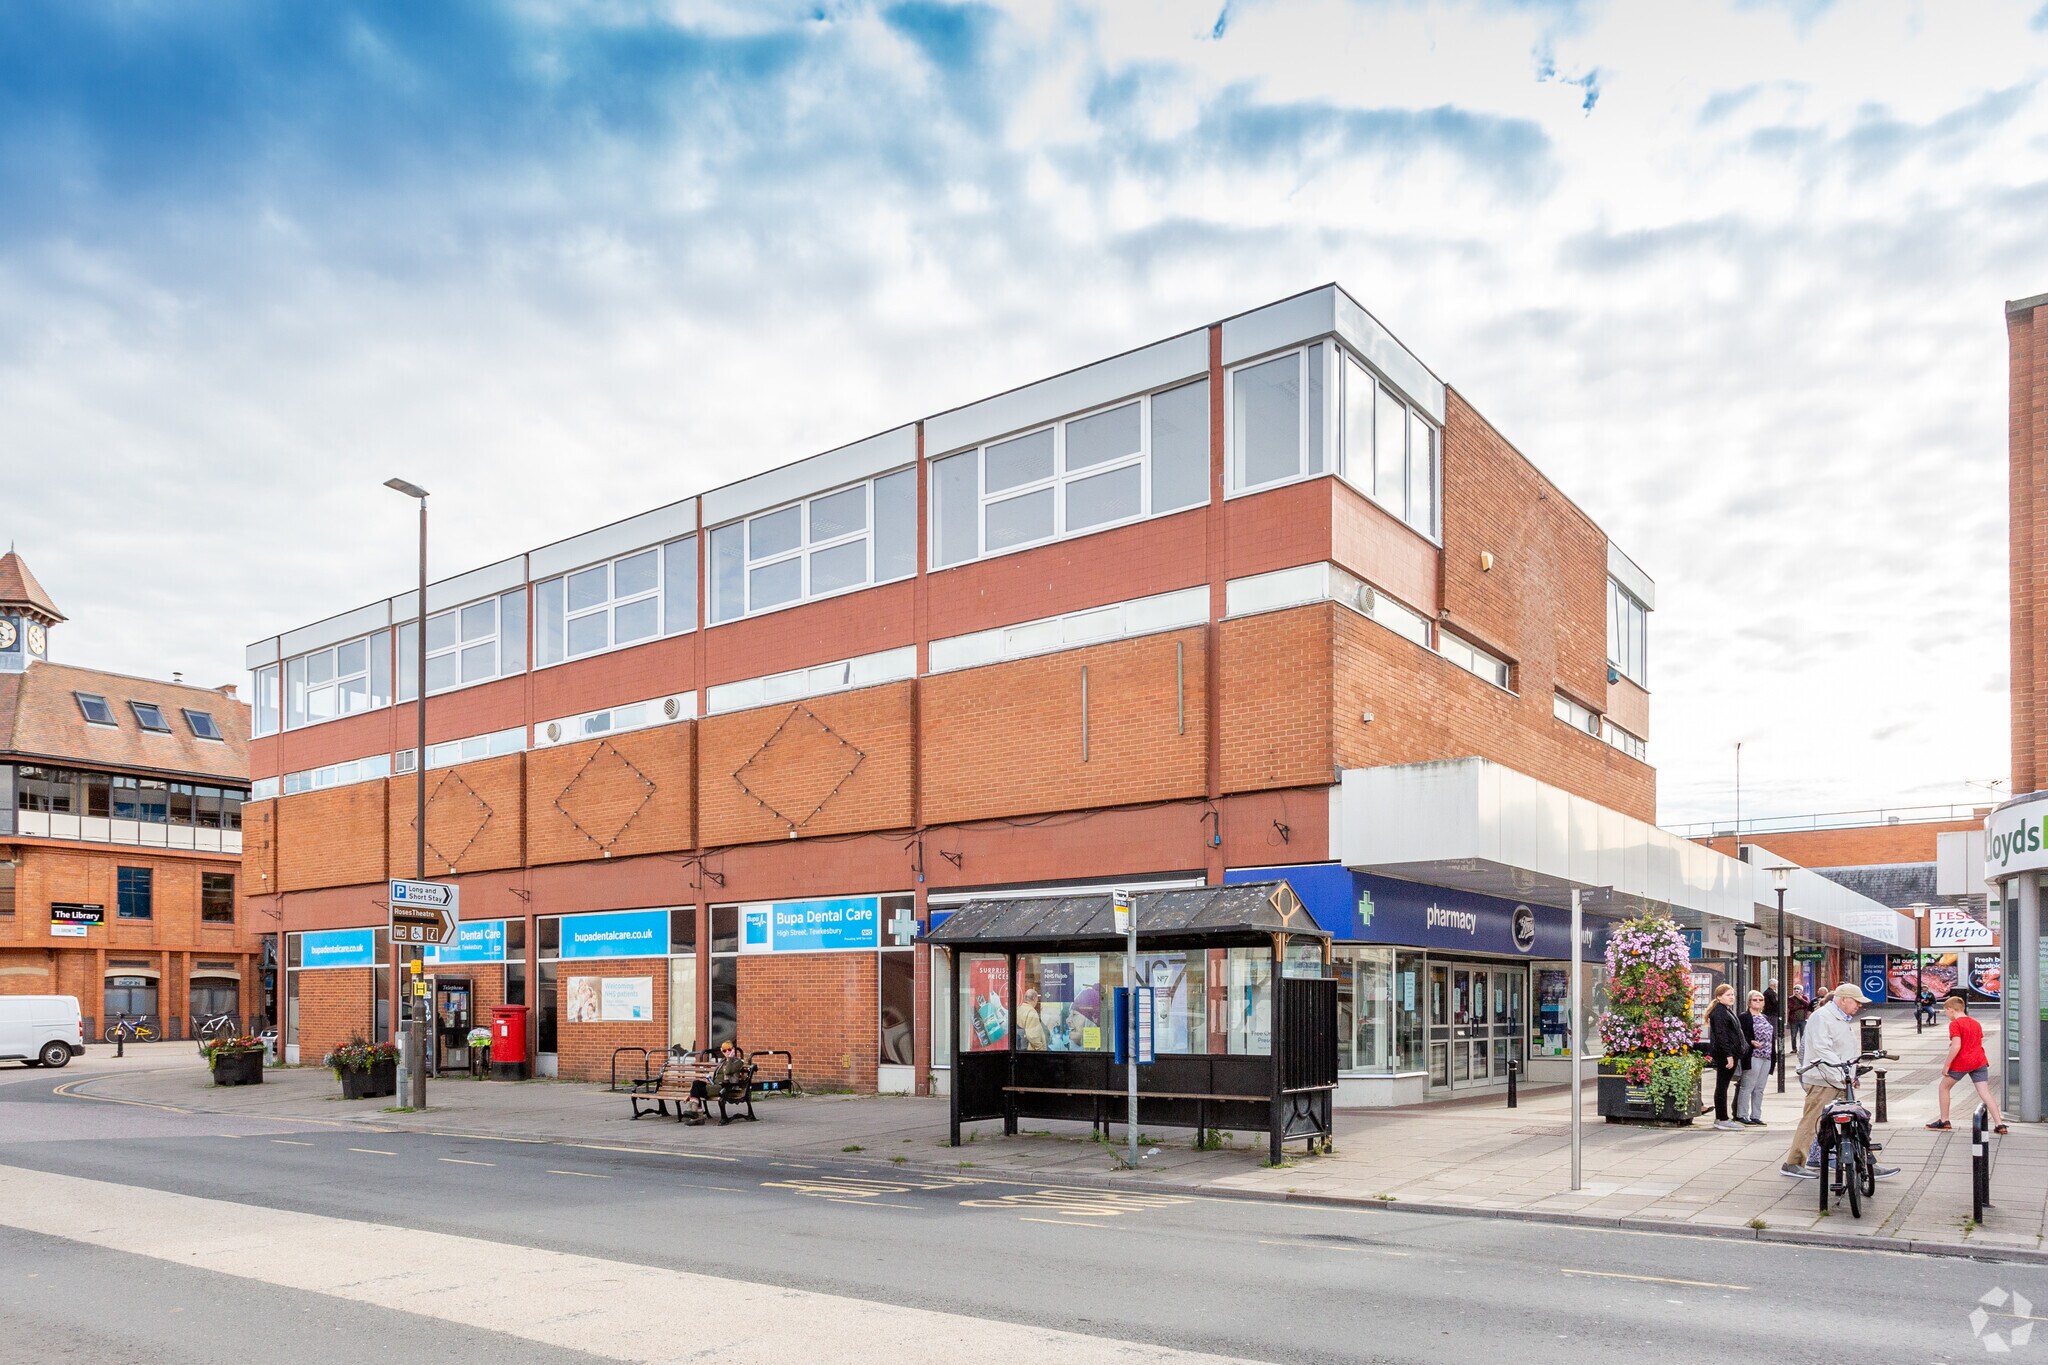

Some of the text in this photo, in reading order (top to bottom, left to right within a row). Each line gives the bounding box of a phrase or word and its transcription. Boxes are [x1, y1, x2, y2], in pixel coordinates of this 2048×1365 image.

[408, 885, 437, 895] Long and
[408, 893, 443, 903] Short Stay
[54, 911, 100, 921] The Library
[776, 908, 873, 926] Bupa Dental Care
[1426, 902, 1477, 935] pharmacy
[460, 929, 501, 941] Dental Care
[574, 928, 653, 943] bupadentalcare.co.uk
[776, 928, 843, 938] High Street, Tewkesbury
[604, 983, 634, 991] Welcoming
[617, 990, 638, 998] patients
